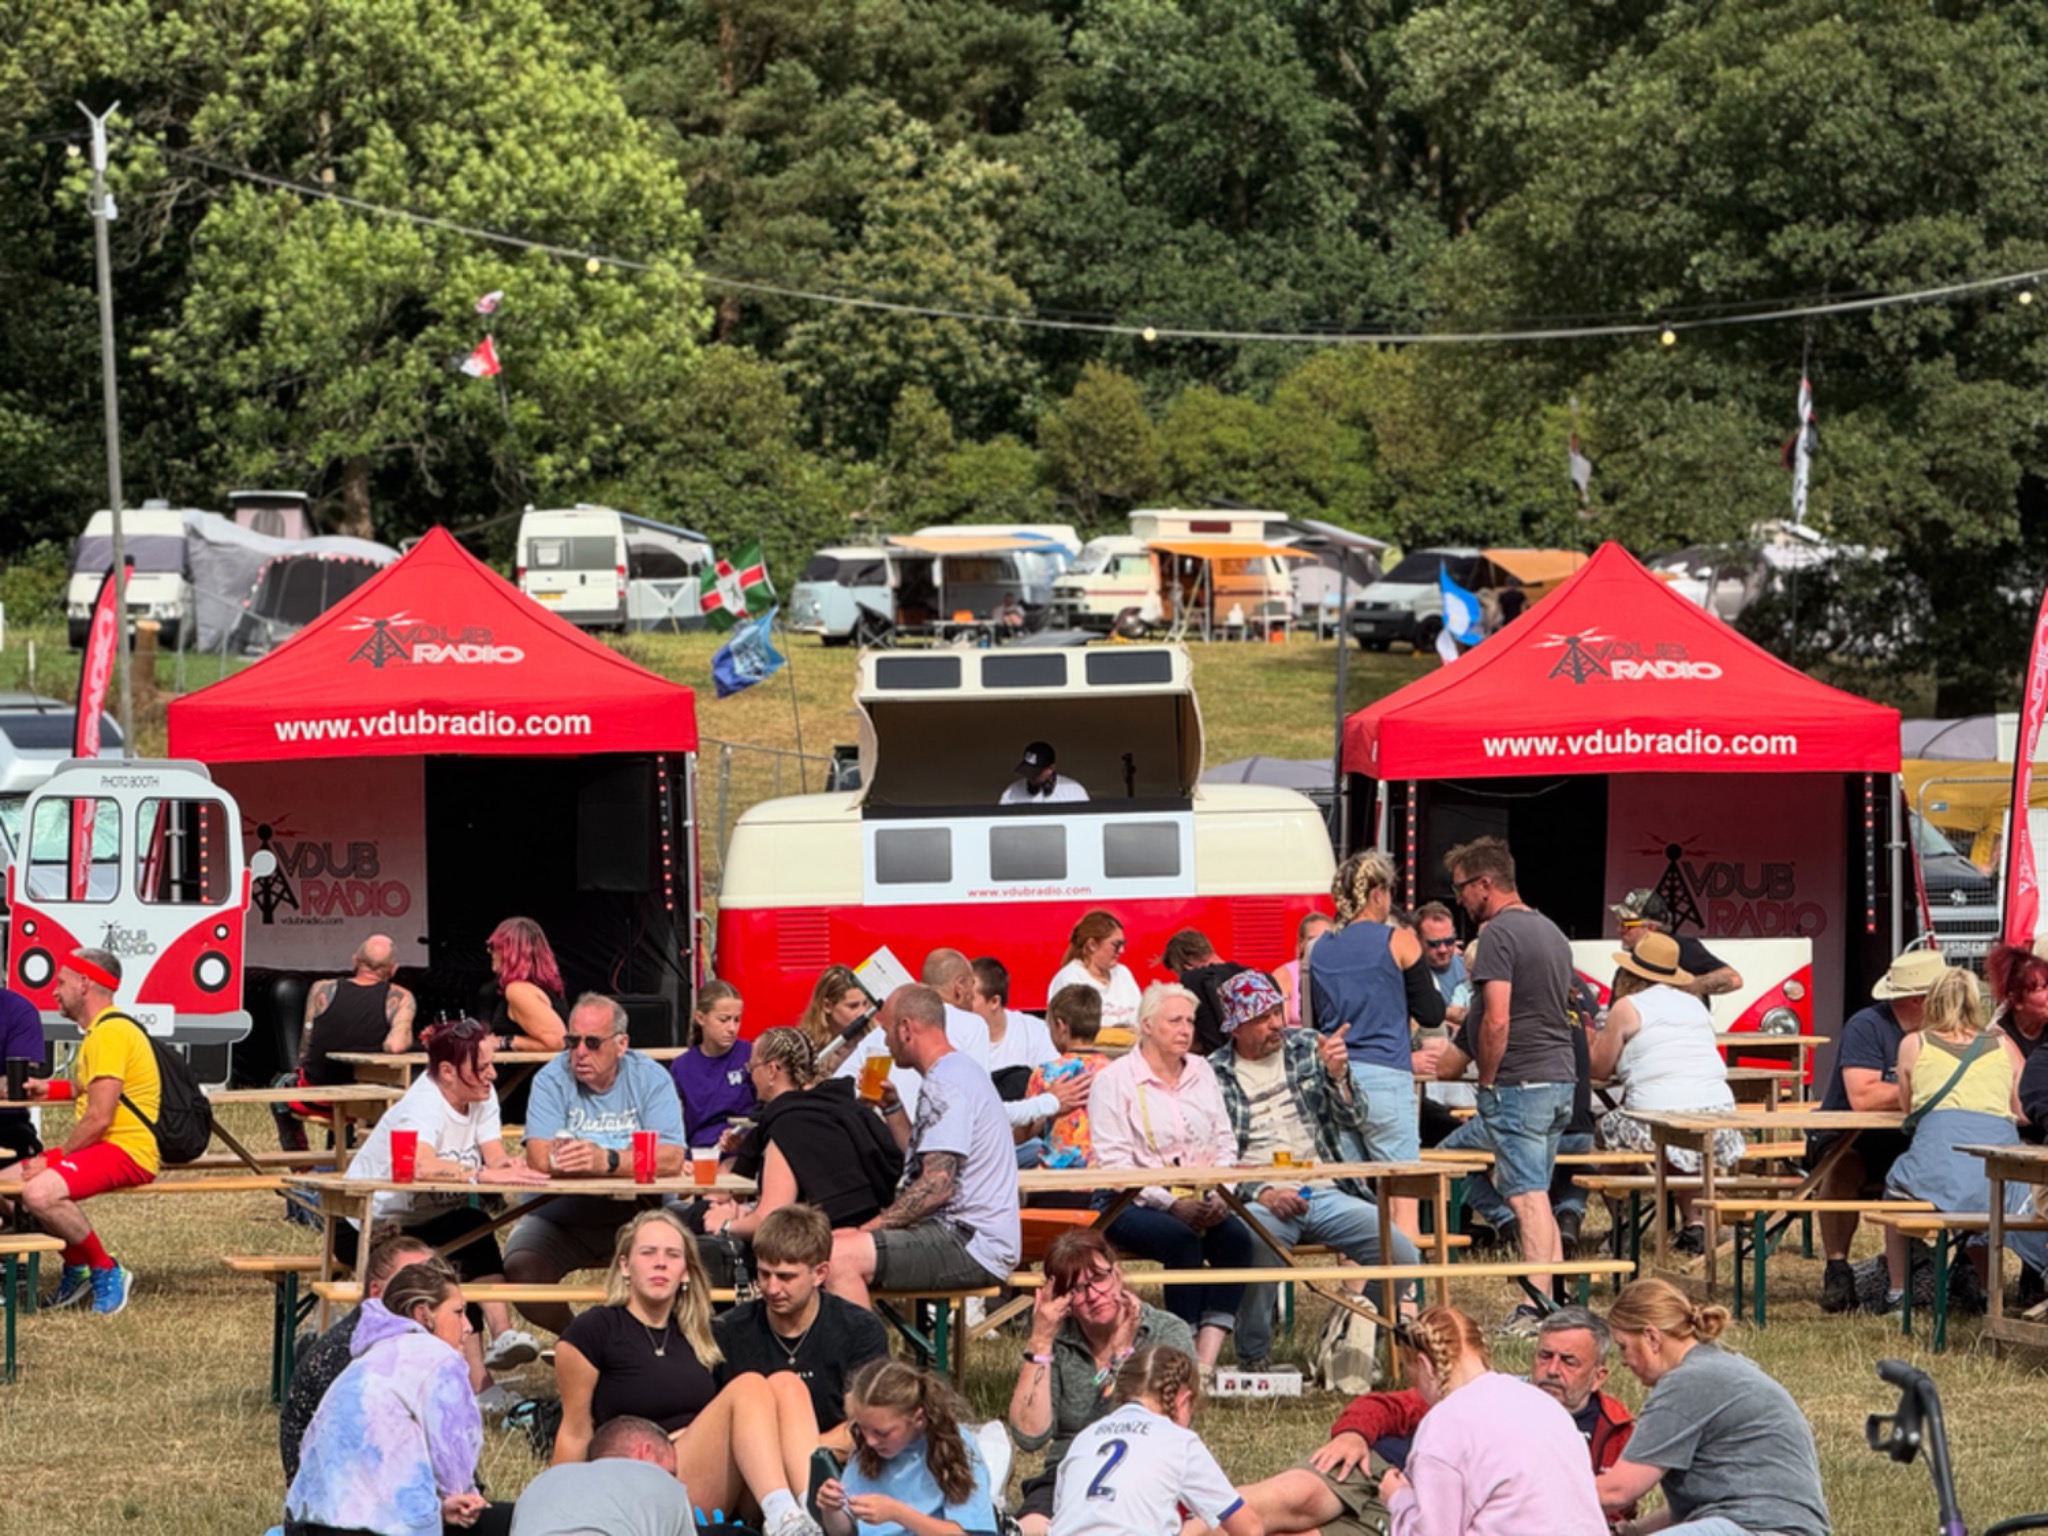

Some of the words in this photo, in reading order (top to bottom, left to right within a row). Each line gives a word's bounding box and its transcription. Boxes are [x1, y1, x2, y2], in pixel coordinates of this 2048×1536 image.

[390, 626, 494, 643] VDUB
[412, 643, 525, 664] RADIO
[1584, 642, 1688, 660] VDUB
[1610, 661, 1723, 680] RADIO
[274, 708, 592, 741] www.vdubradio.com
[1483, 728, 1797, 757] www.vdubradio.com
[101, 775, 128, 788] PHOTO
[130, 775, 160, 788] BOOTH
[273, 841, 379, 879] VDUB
[967, 885, 1092, 898] www.vdubradio.com
[1682, 862, 1796, 900] VDUB
[300, 880, 411, 917] RADIO
[1707, 902, 1828, 938] RADIO
[1085, 1437, 1129, 1501] 2
